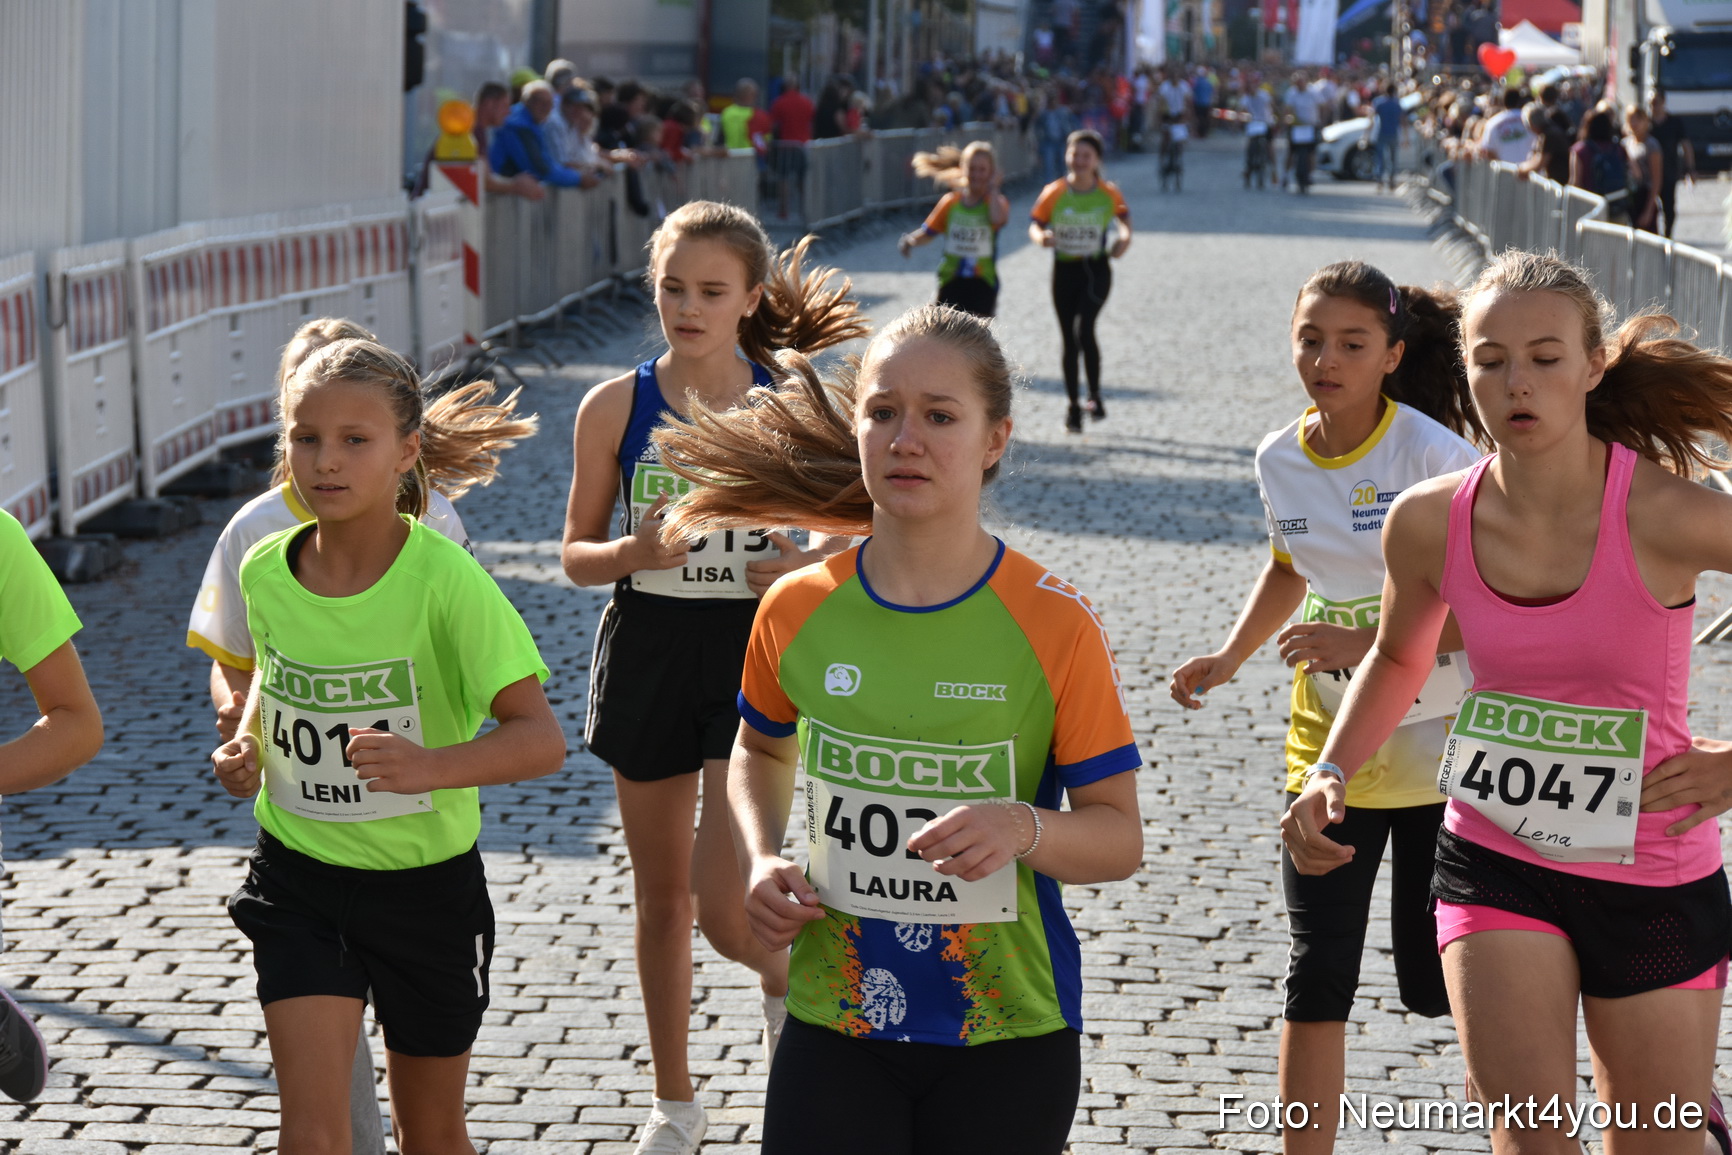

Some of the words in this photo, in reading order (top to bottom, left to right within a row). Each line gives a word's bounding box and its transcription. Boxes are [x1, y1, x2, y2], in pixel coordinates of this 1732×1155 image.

[1352, 486, 1376, 506] 20
[682, 566, 735, 583] LISA
[264, 655, 400, 709] BOCK
[934, 682, 1007, 702] BOCK
[272, 709, 391, 769] 401
[1466, 696, 1628, 753] BOCK
[818, 732, 996, 794] BOCK
[1460, 750, 1616, 814] 4047
[301, 780, 362, 804] LENI
[824, 795, 964, 861] 402
[1512, 816, 1572, 848] Lena
[849, 871, 958, 903] LAURA
